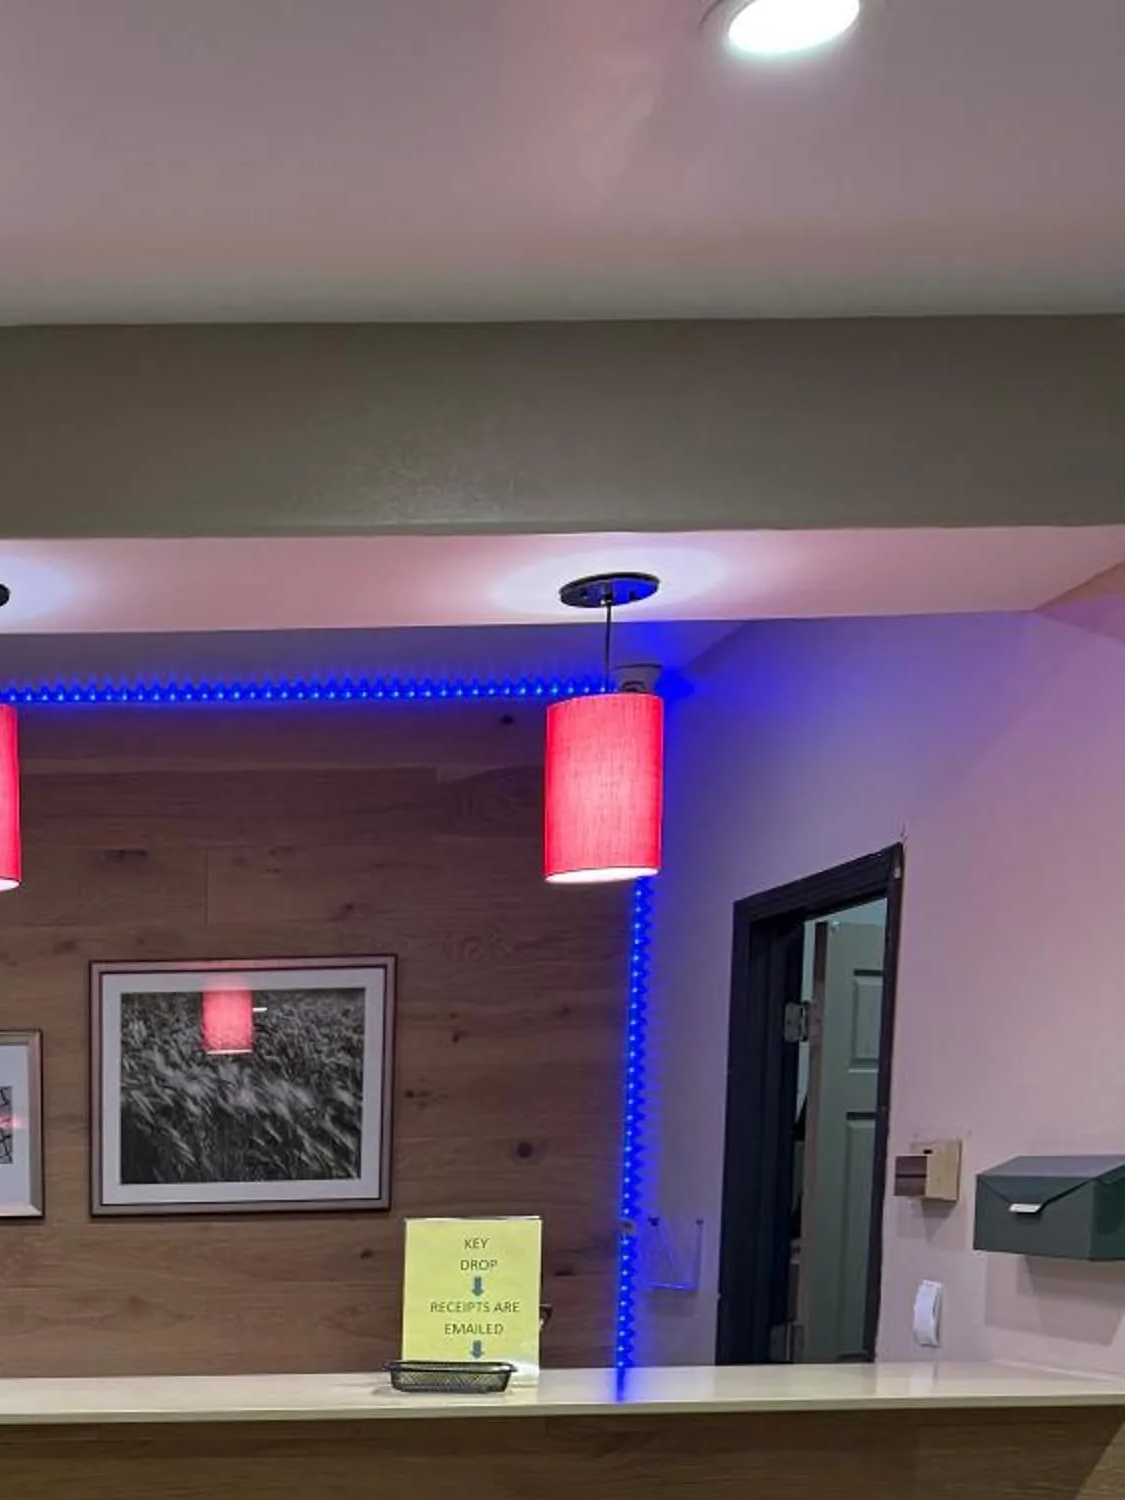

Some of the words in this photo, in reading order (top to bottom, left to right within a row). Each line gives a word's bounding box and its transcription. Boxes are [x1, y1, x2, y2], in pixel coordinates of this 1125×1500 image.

[463, 1237, 491, 1250] KEY
[460, 1259, 498, 1271] DROP
[430, 1300, 491, 1314] RECEIPTS
[492, 1301, 521, 1313] ARE
[443, 1322, 505, 1336] EMAILED
